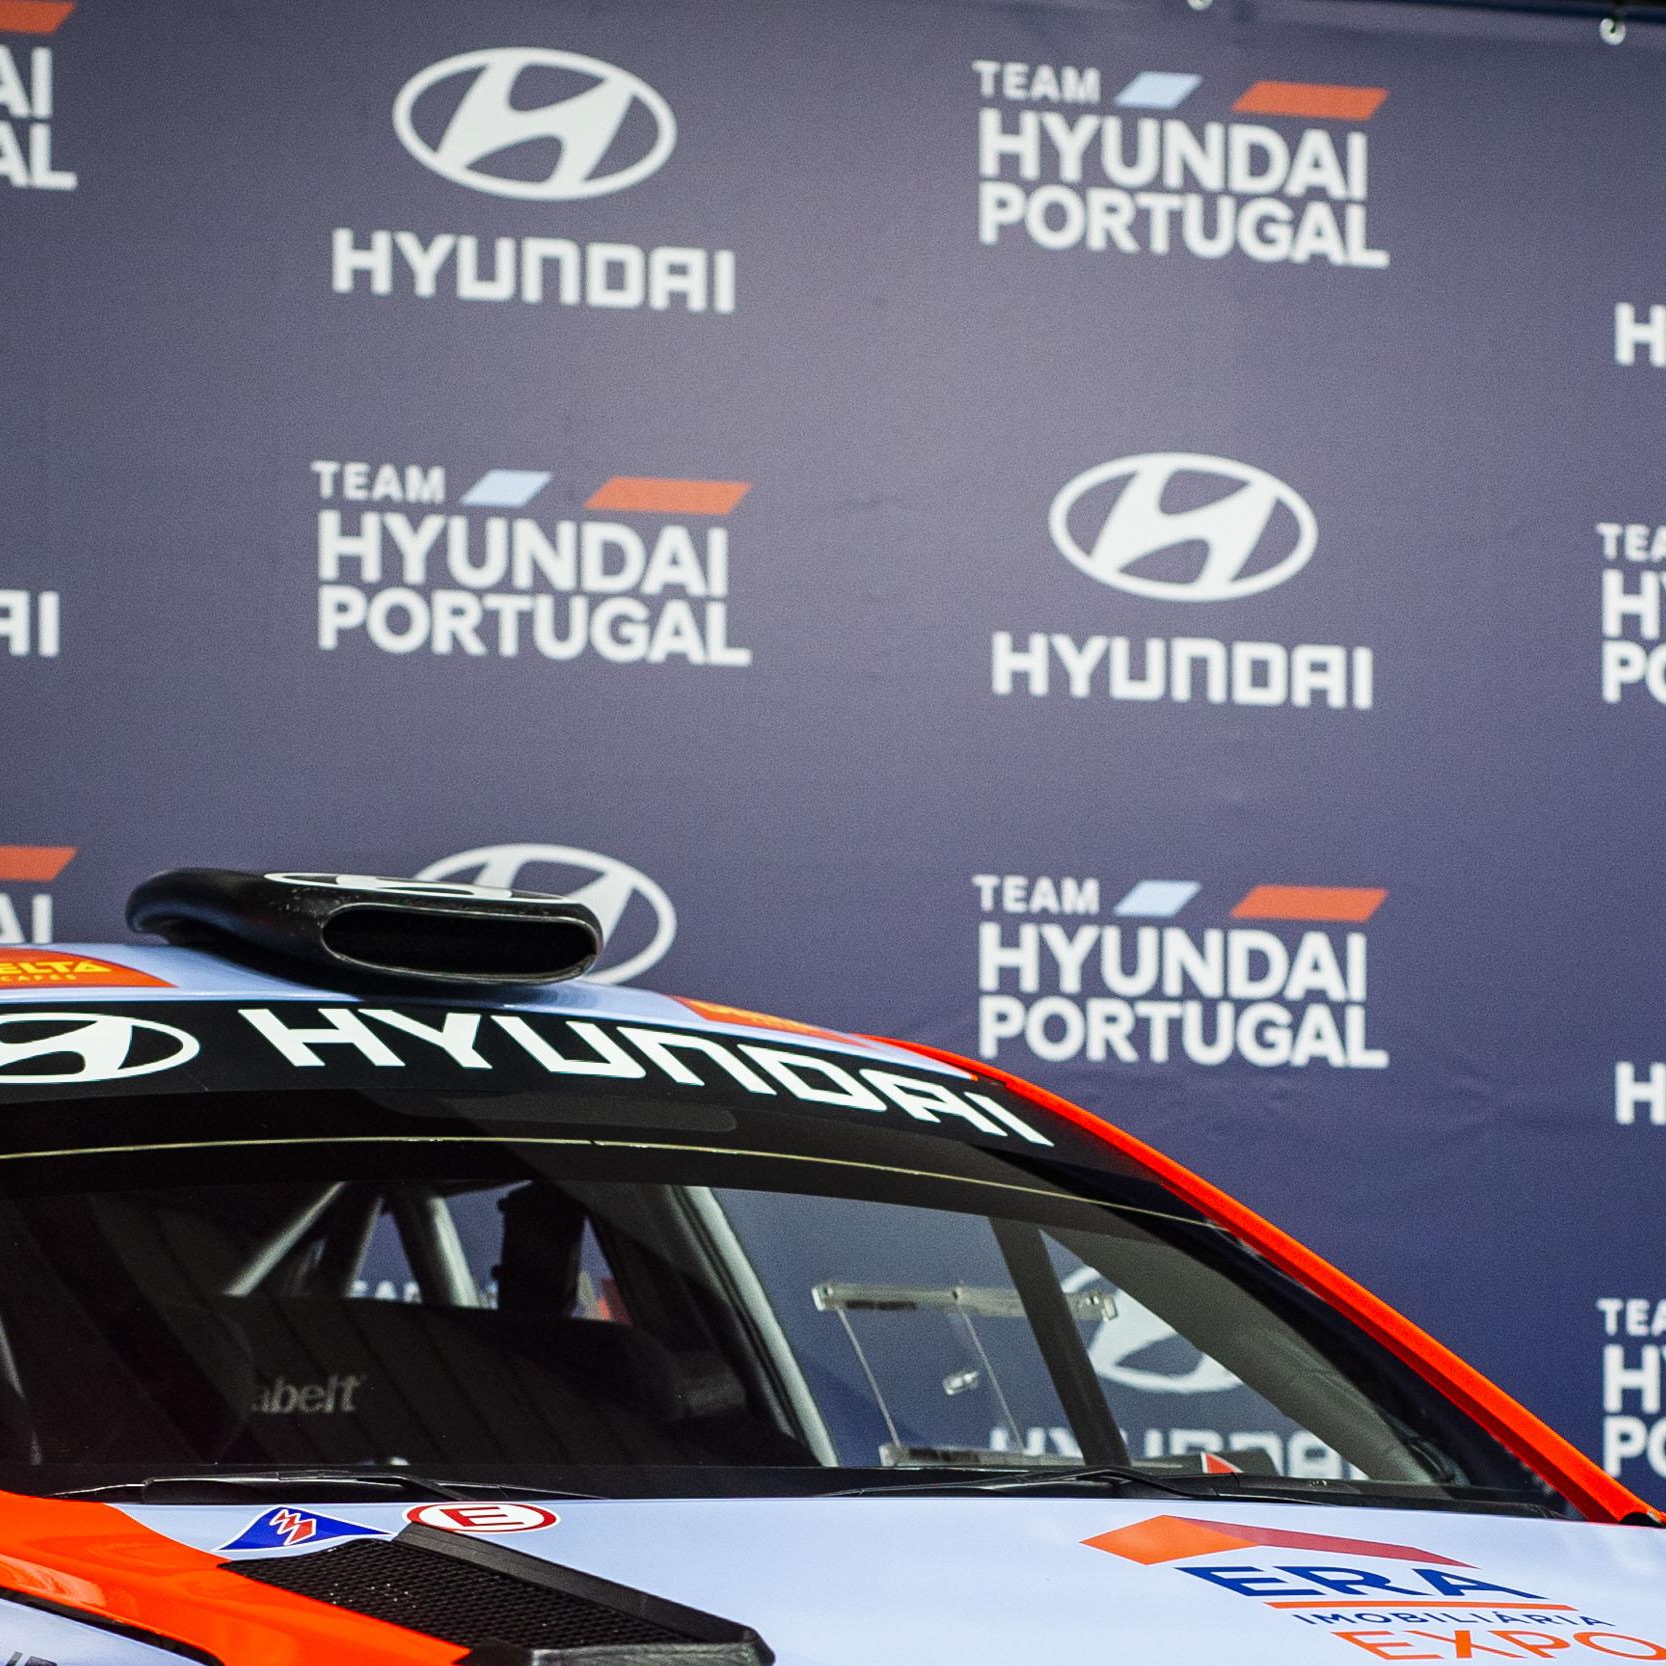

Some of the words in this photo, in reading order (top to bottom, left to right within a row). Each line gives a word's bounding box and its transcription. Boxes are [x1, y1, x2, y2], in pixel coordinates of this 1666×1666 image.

[972, 60, 1100, 105] TEAM
[978, 106, 1367, 200] HYUNDAI
[978, 182, 1389, 269] PORTUGAL
[332, 228, 735, 313] HYUNDAI
[311, 459, 445, 503] TEAM
[317, 510, 728, 598] HYUNDAI
[317, 586, 752, 668] PORTUGAL
[991, 630, 1374, 709] HYUNDAI
[973, 874, 1099, 916] TEAM
[978, 922, 1367, 1003] HYUNDAI
[978, 994, 1390, 1070] PORTUGAL
[237, 1007, 1055, 1148] HYUNDAI
[1174, 1565, 1552, 1600] ERA
[1291, 1608, 1617, 1627] IMOBILIÁRIA
